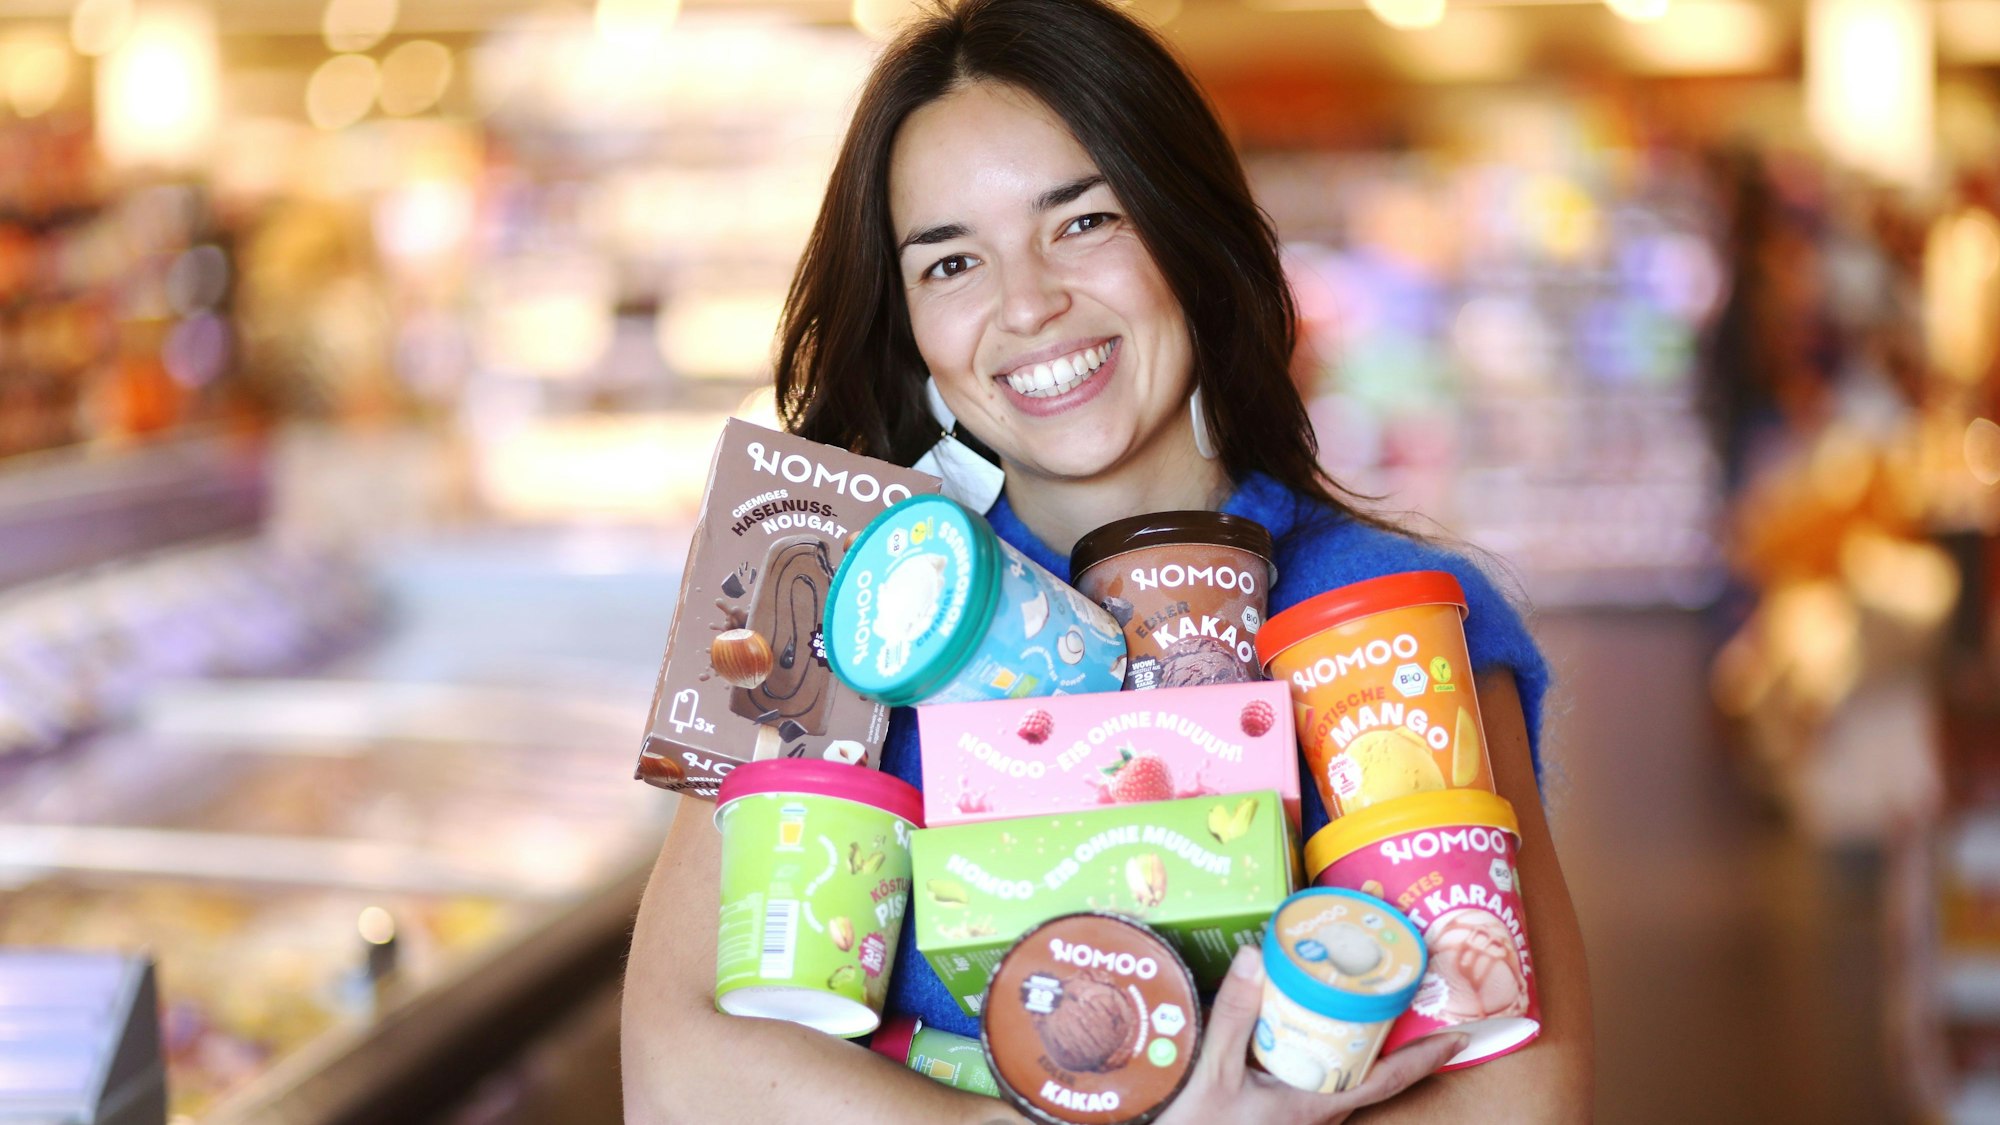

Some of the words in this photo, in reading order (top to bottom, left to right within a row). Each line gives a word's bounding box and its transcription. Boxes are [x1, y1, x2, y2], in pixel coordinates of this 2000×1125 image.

[747, 442, 912, 508] NOMOO
[731, 500, 838, 536] HASELNUSS-
[732, 489, 788, 518] CREMIGES
[762, 514, 847, 539] NOUGAT
[1131, 564, 1255, 595] NOMOO
[852, 570, 873, 665] NOMOO
[1136, 601, 1190, 639] EDLER
[1152, 615, 1253, 663] KAKAO
[1132, 659, 1156, 671] WOW!
[1135, 671, 1155, 684] 29
[1293, 634, 1418, 693] NOMOO
[1400, 672, 1421, 684] BIO
[694, 717, 715, 734] 3x
[1314, 686, 1386, 760] EXOTISCHE
[1330, 702, 1449, 750] MANGO
[958, 732, 1046, 778] NOMOO
[1057, 740, 1091, 772] EIS
[1088, 711, 1152, 745] OHNE
[1155, 712, 1243, 762] MUUUH!
[946, 854, 1034, 899] NOMOO
[1044, 858, 1080, 890] EIS
[1075, 825, 1139, 863] OHNE
[1142, 825, 1231, 876] MUUUH!
[1380, 828, 1506, 865] NOMOO
[1397, 871, 1444, 911] RTES
[1424, 884, 1531, 977] KARAMELL
[1049, 938, 1158, 980] NOMOO
[1040, 1080, 1119, 1111] KAKAO
